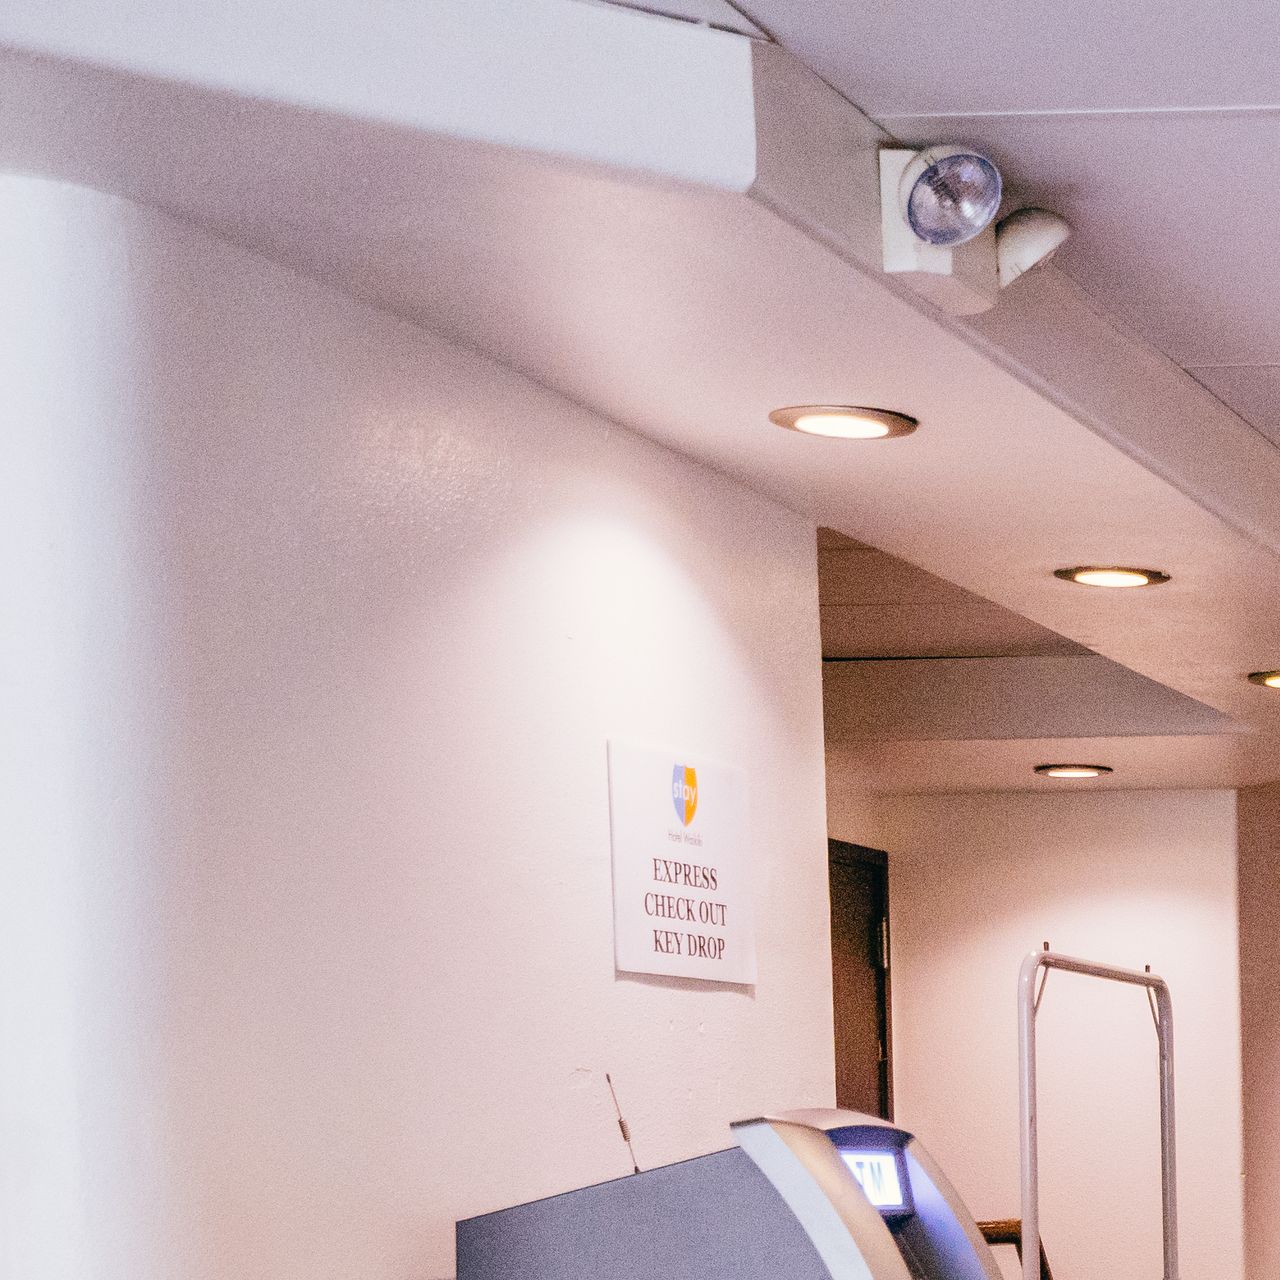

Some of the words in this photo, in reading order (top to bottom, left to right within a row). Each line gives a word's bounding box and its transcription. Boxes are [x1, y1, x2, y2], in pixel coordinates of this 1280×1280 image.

[673, 780, 697, 806] stay
[653, 858, 718, 890] EXPRESS
[644, 892, 696, 922] CHECK
[699, 901, 727, 926] OUT
[653, 929, 683, 955] KEY
[687, 935, 726, 960] DROP
